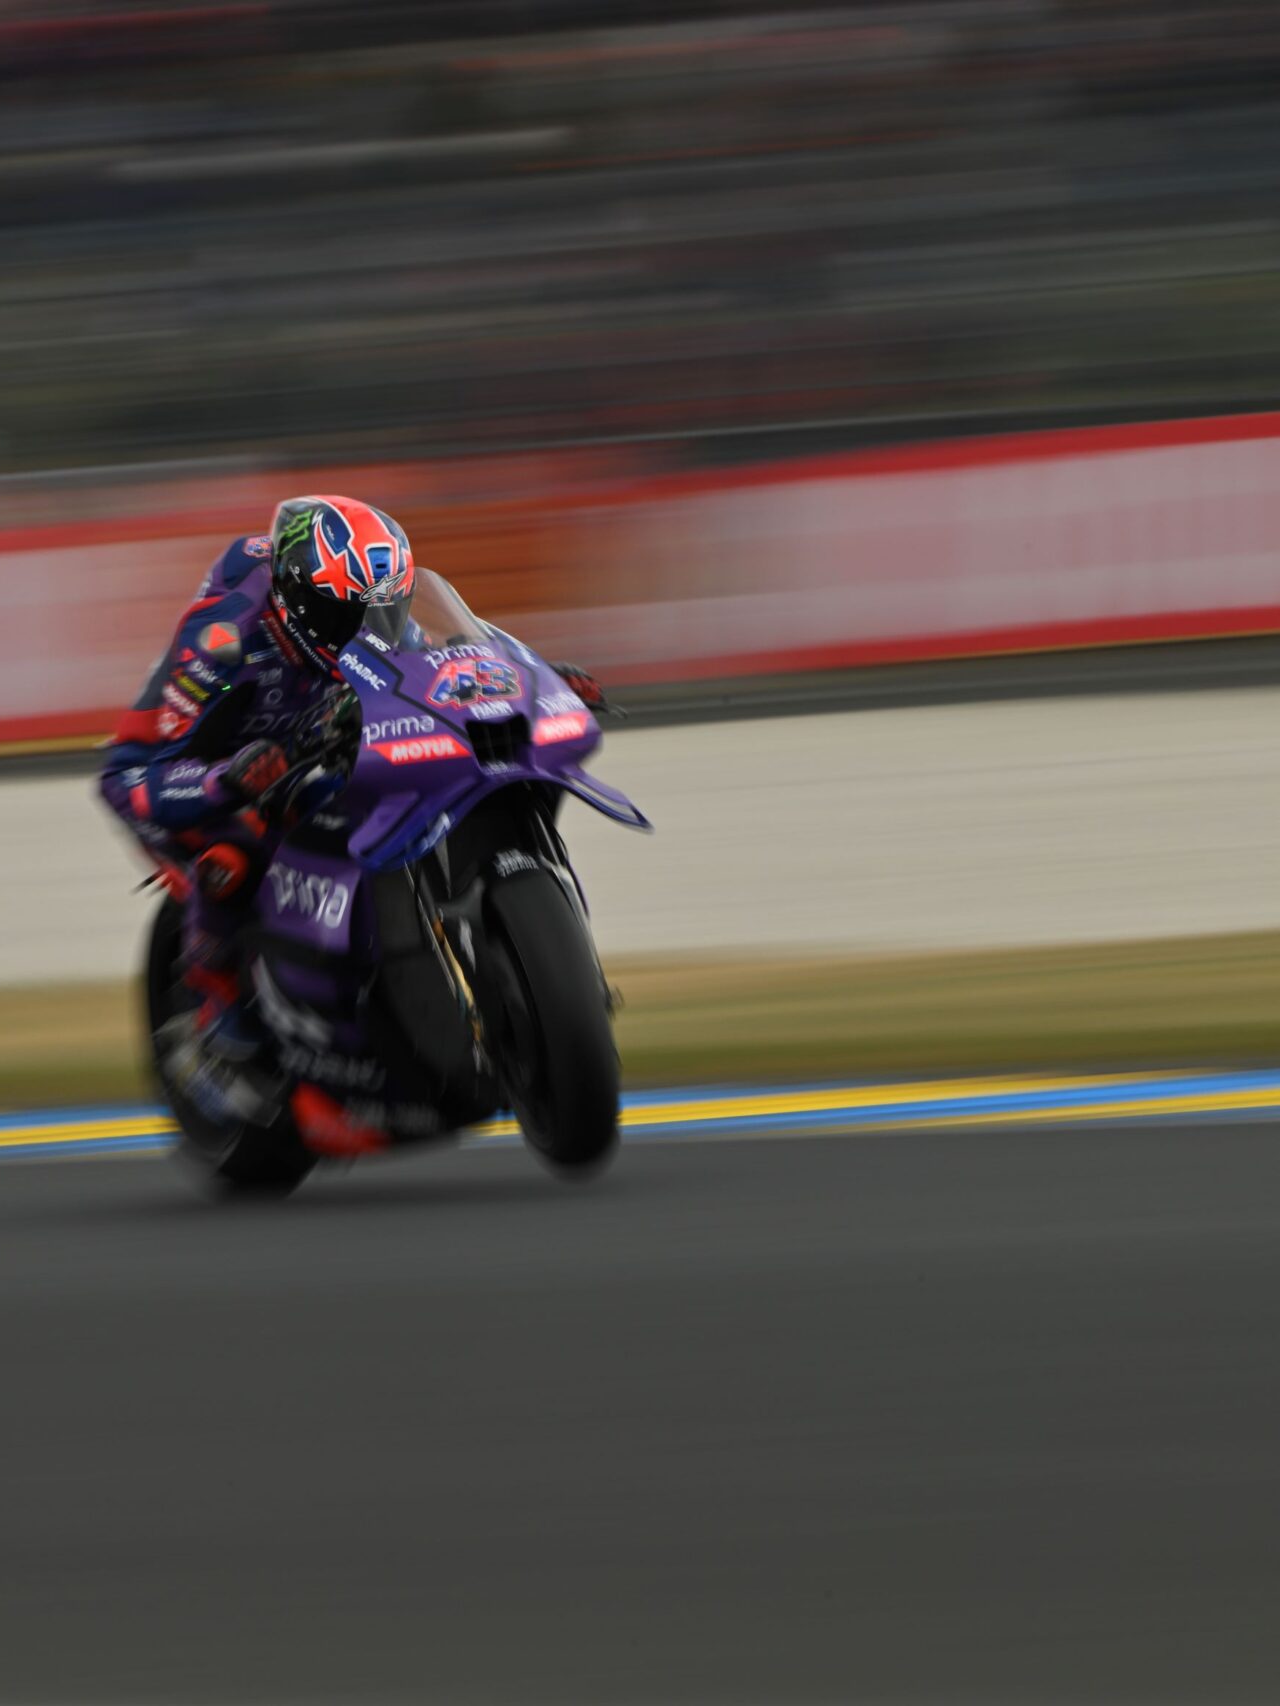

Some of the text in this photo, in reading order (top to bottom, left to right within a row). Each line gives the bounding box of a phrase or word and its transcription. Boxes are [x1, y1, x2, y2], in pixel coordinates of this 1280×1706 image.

[339, 652, 387, 691] PRAMAC
[426, 657, 524, 710] 43
[362, 715, 435, 747] prima
[391, 738, 457, 762] MOTUL
